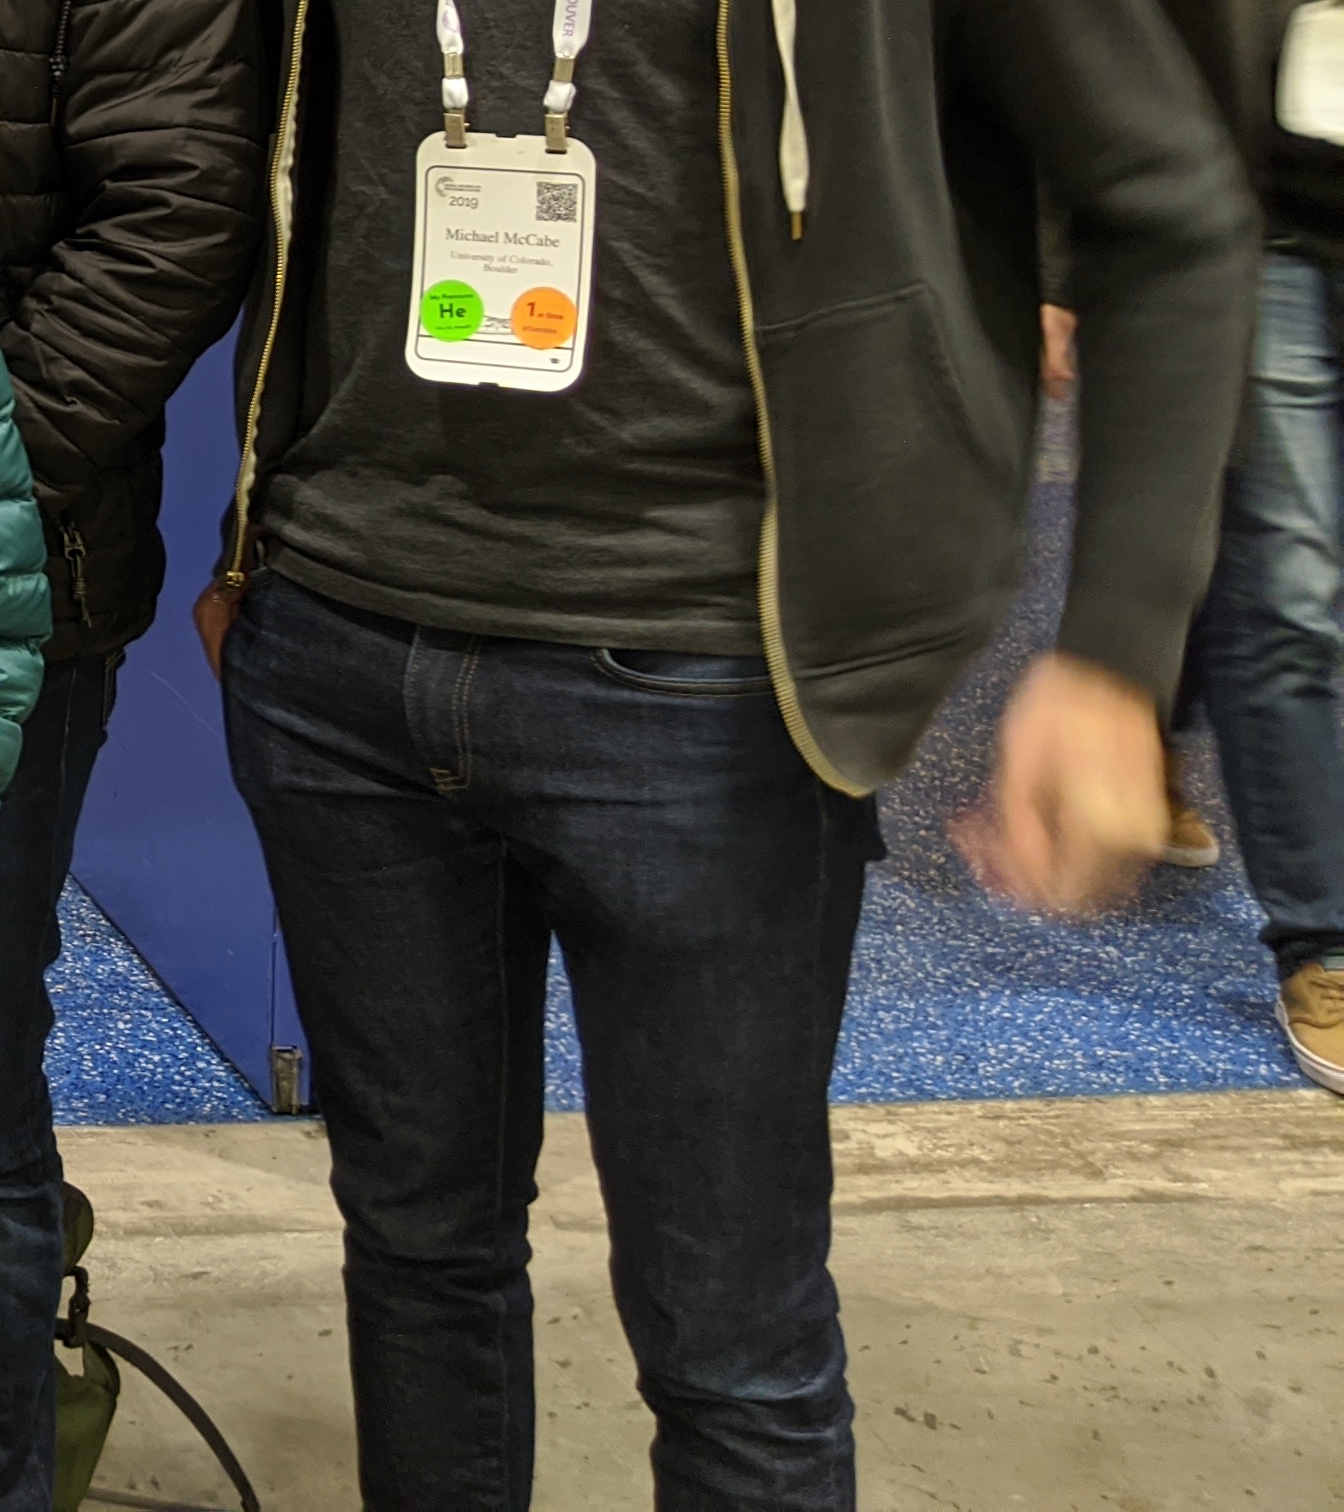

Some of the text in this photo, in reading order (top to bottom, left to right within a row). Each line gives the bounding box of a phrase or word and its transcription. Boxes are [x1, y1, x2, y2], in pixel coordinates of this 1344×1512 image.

[449, 196, 479, 209] 2019
[445, 228, 560, 248] Michael McCabe
[450, 251, 494, 263] University
[497, 252, 507, 262] of
[483, 263, 518, 274] Boulder
[439, 302, 467, 319] He
